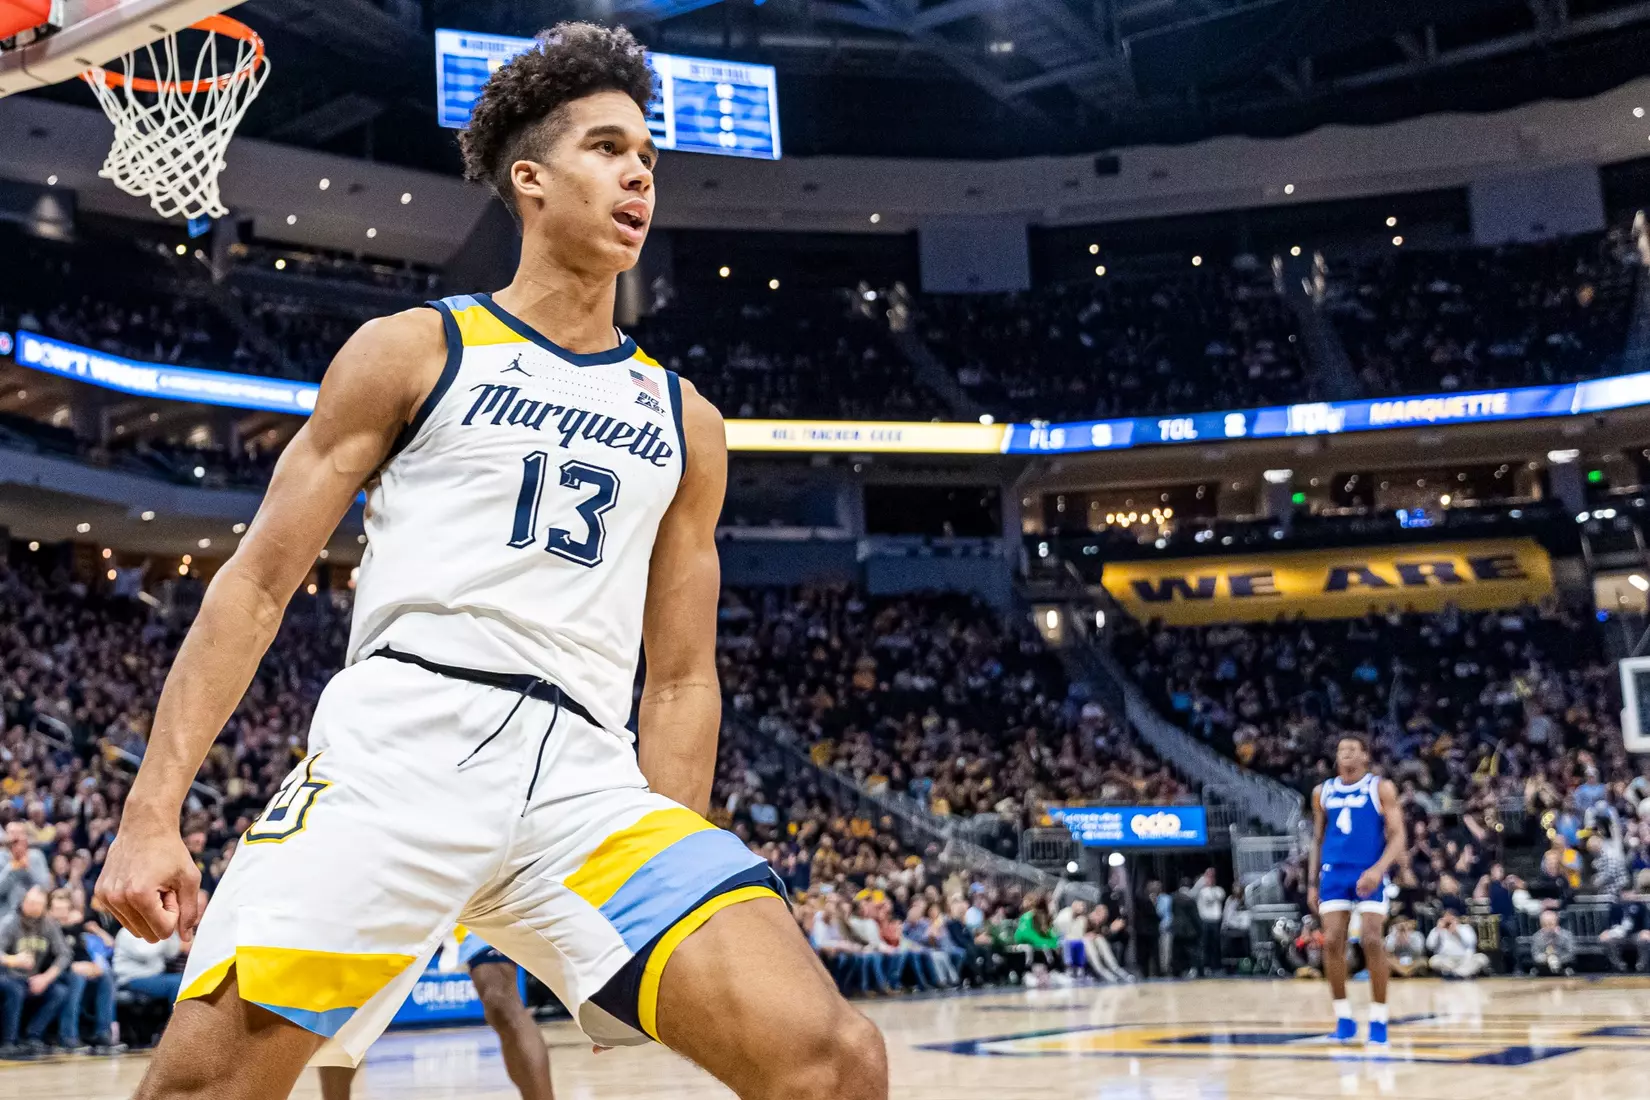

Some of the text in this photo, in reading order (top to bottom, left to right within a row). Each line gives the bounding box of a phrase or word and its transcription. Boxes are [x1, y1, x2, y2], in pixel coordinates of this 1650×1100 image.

[636, 396, 666, 414] EAST
[639, 391, 659, 406] BIG
[1369, 392, 1508, 425] MARQUETTE
[461, 384, 673, 467] Marquette
[506, 450, 621, 569] 13
[1130, 553, 1529, 600] WE ARE
[1336, 806, 1353, 835] 4
